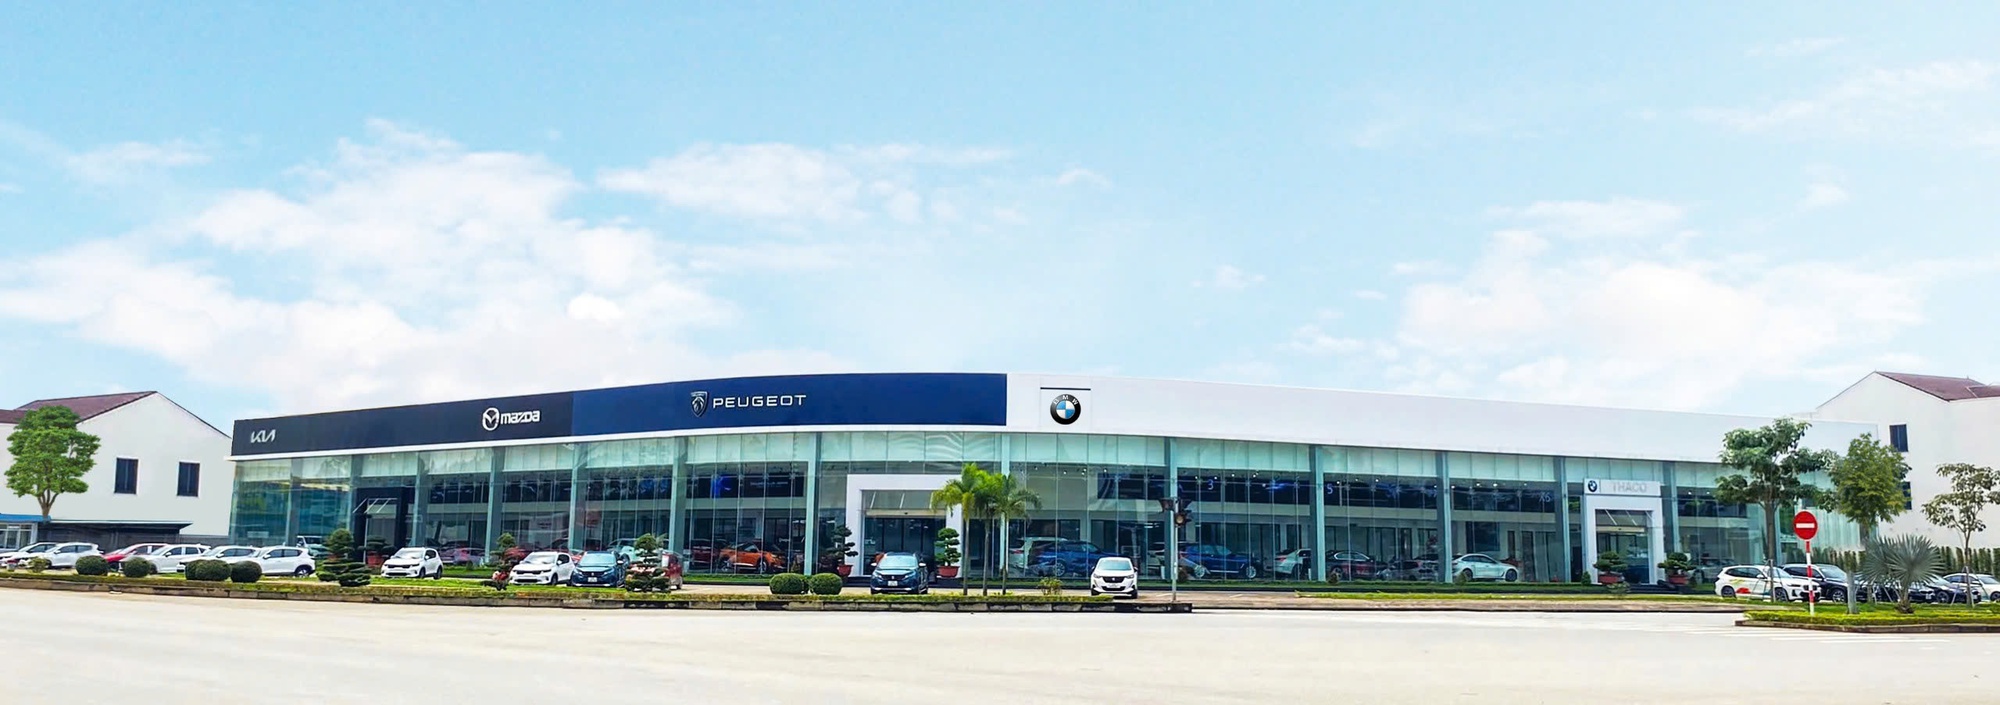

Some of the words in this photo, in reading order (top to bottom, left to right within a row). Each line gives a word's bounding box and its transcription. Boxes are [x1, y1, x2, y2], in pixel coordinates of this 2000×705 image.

[713, 395, 807, 409] PEUGEOT
[250, 429, 276, 443] KIA
[1612, 481, 1648, 493] THACO
